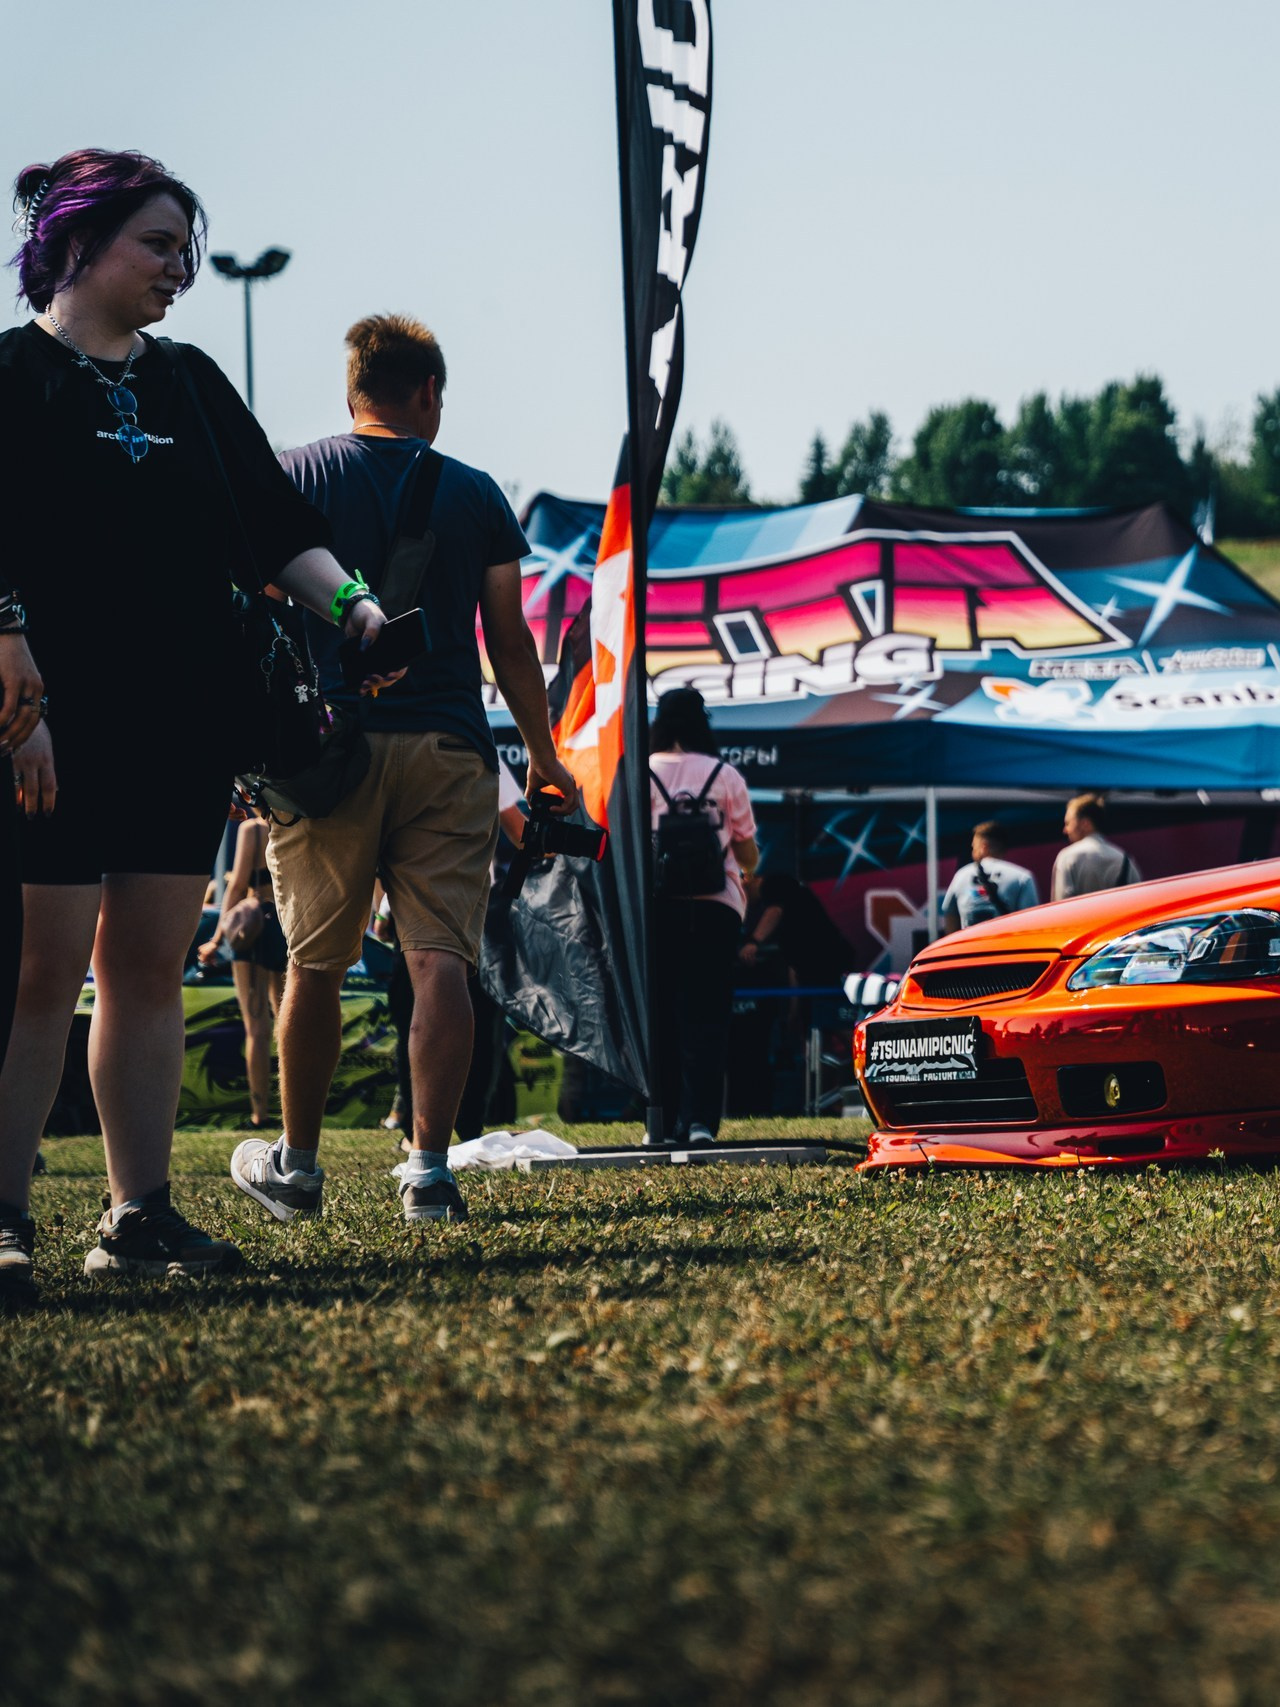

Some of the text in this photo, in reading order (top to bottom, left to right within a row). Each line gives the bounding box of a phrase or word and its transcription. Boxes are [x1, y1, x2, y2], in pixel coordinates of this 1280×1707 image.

[96, 430, 174, 444] arctic infusion
[870, 1034, 974, 1060] #TSUNAMIPICNIC
